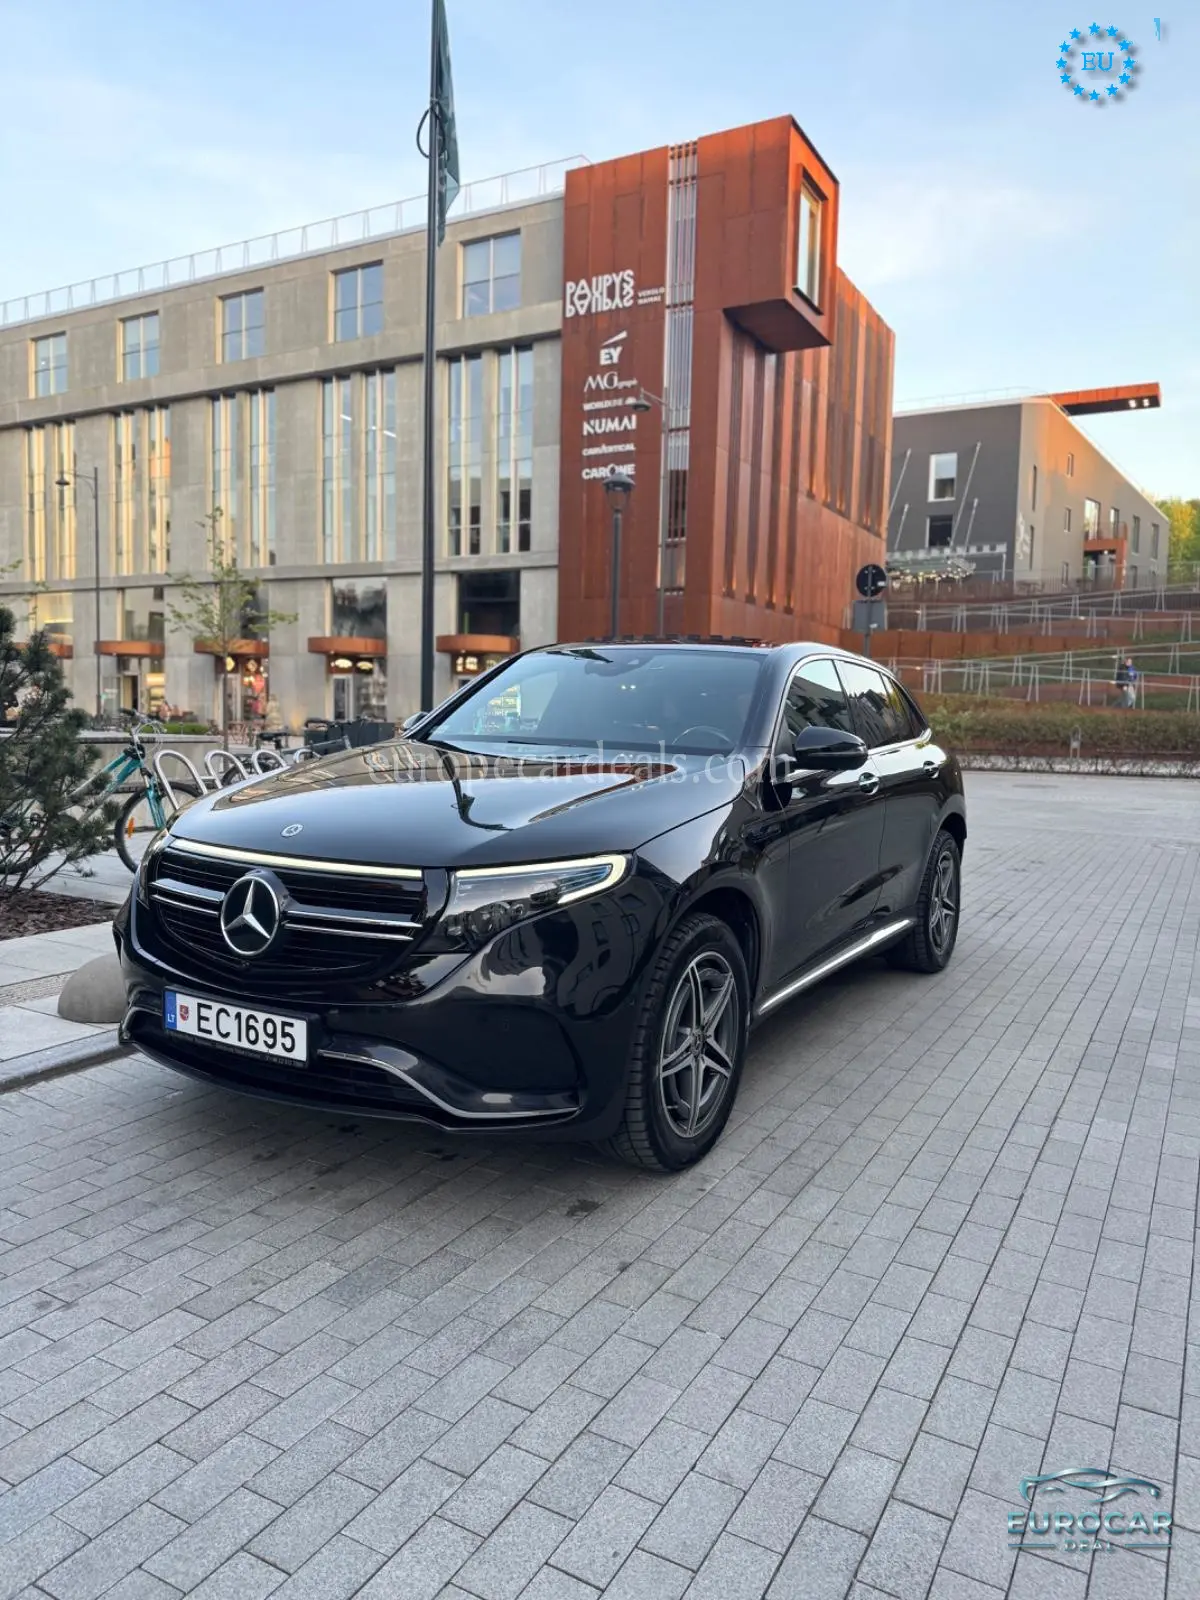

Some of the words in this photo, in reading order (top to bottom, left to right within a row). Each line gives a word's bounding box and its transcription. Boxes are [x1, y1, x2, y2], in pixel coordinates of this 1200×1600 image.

[600, 347, 622, 365] EY
[583, 414, 637, 436] NUMAI
[197, 1002, 296, 1053] EC1695
